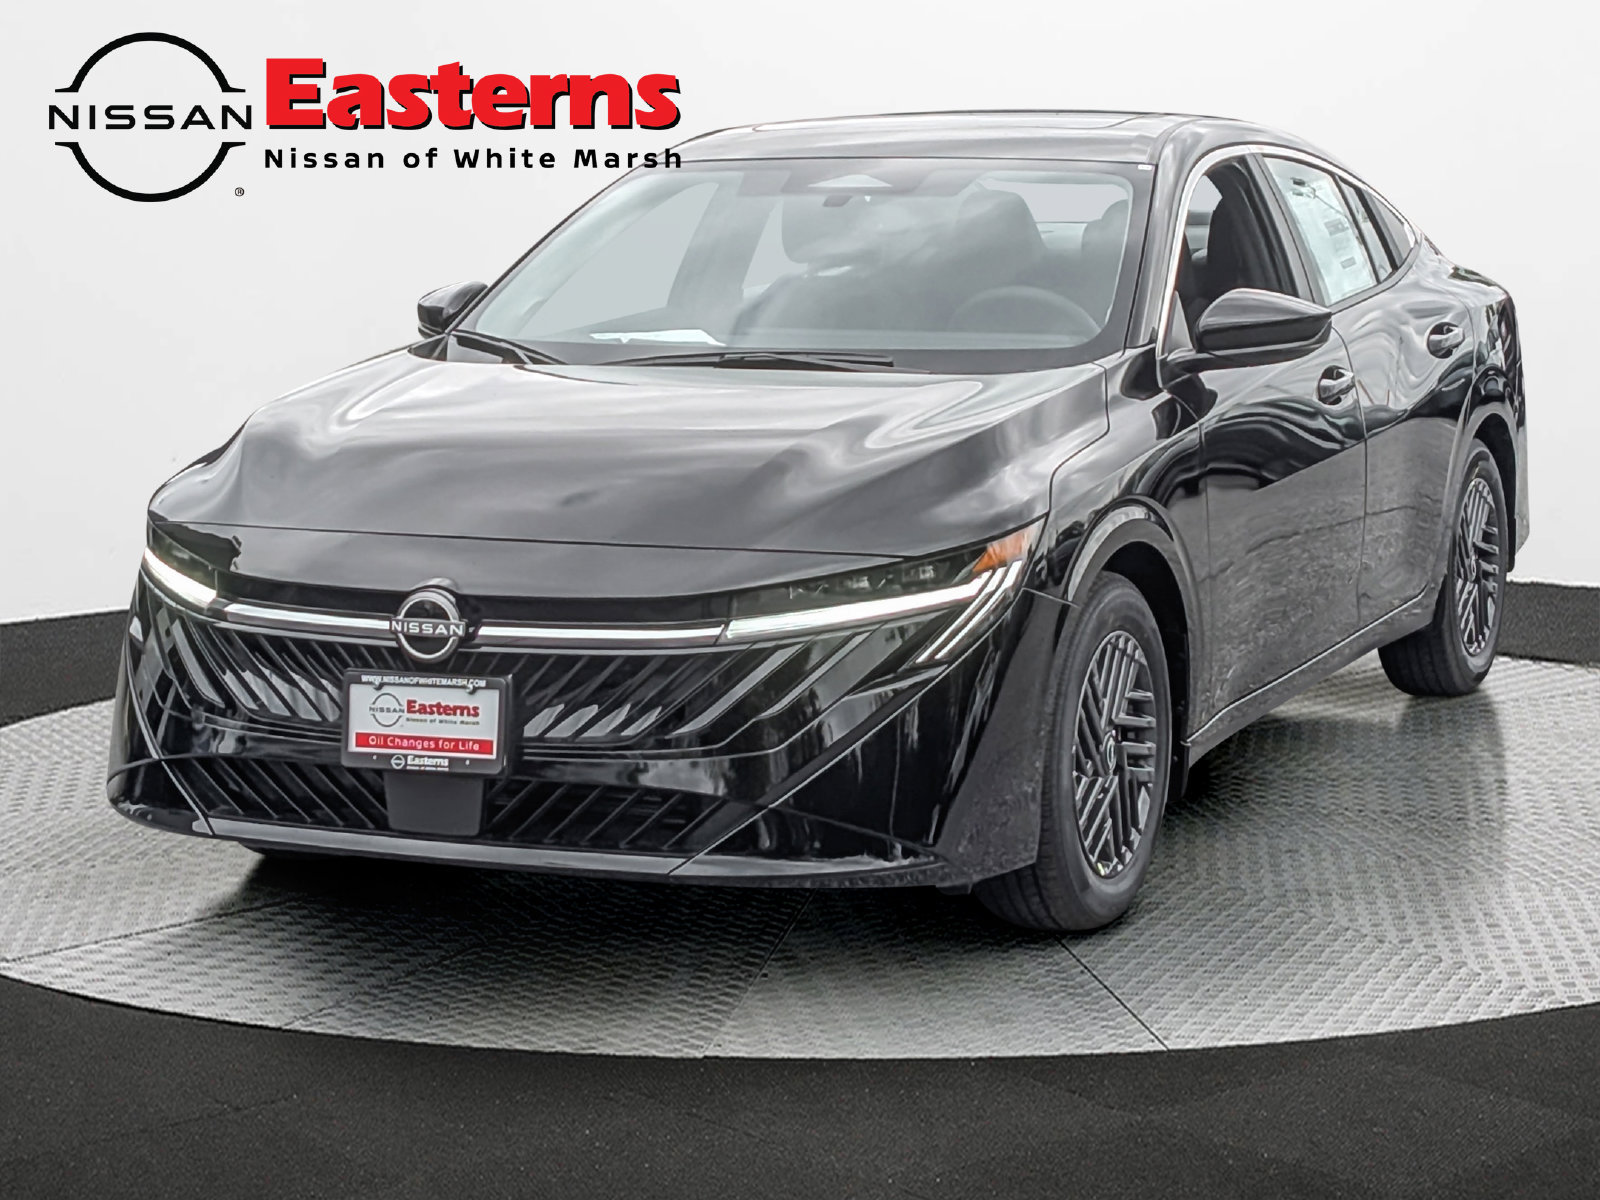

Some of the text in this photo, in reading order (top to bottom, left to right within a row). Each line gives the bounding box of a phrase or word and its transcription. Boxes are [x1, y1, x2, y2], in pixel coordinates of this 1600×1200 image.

[391, 620, 465, 636] NISSAN
[368, 706, 405, 714] NISSAN
[406, 699, 480, 718] Easterns
[368, 735, 480, 751] Oil Changes for Life
